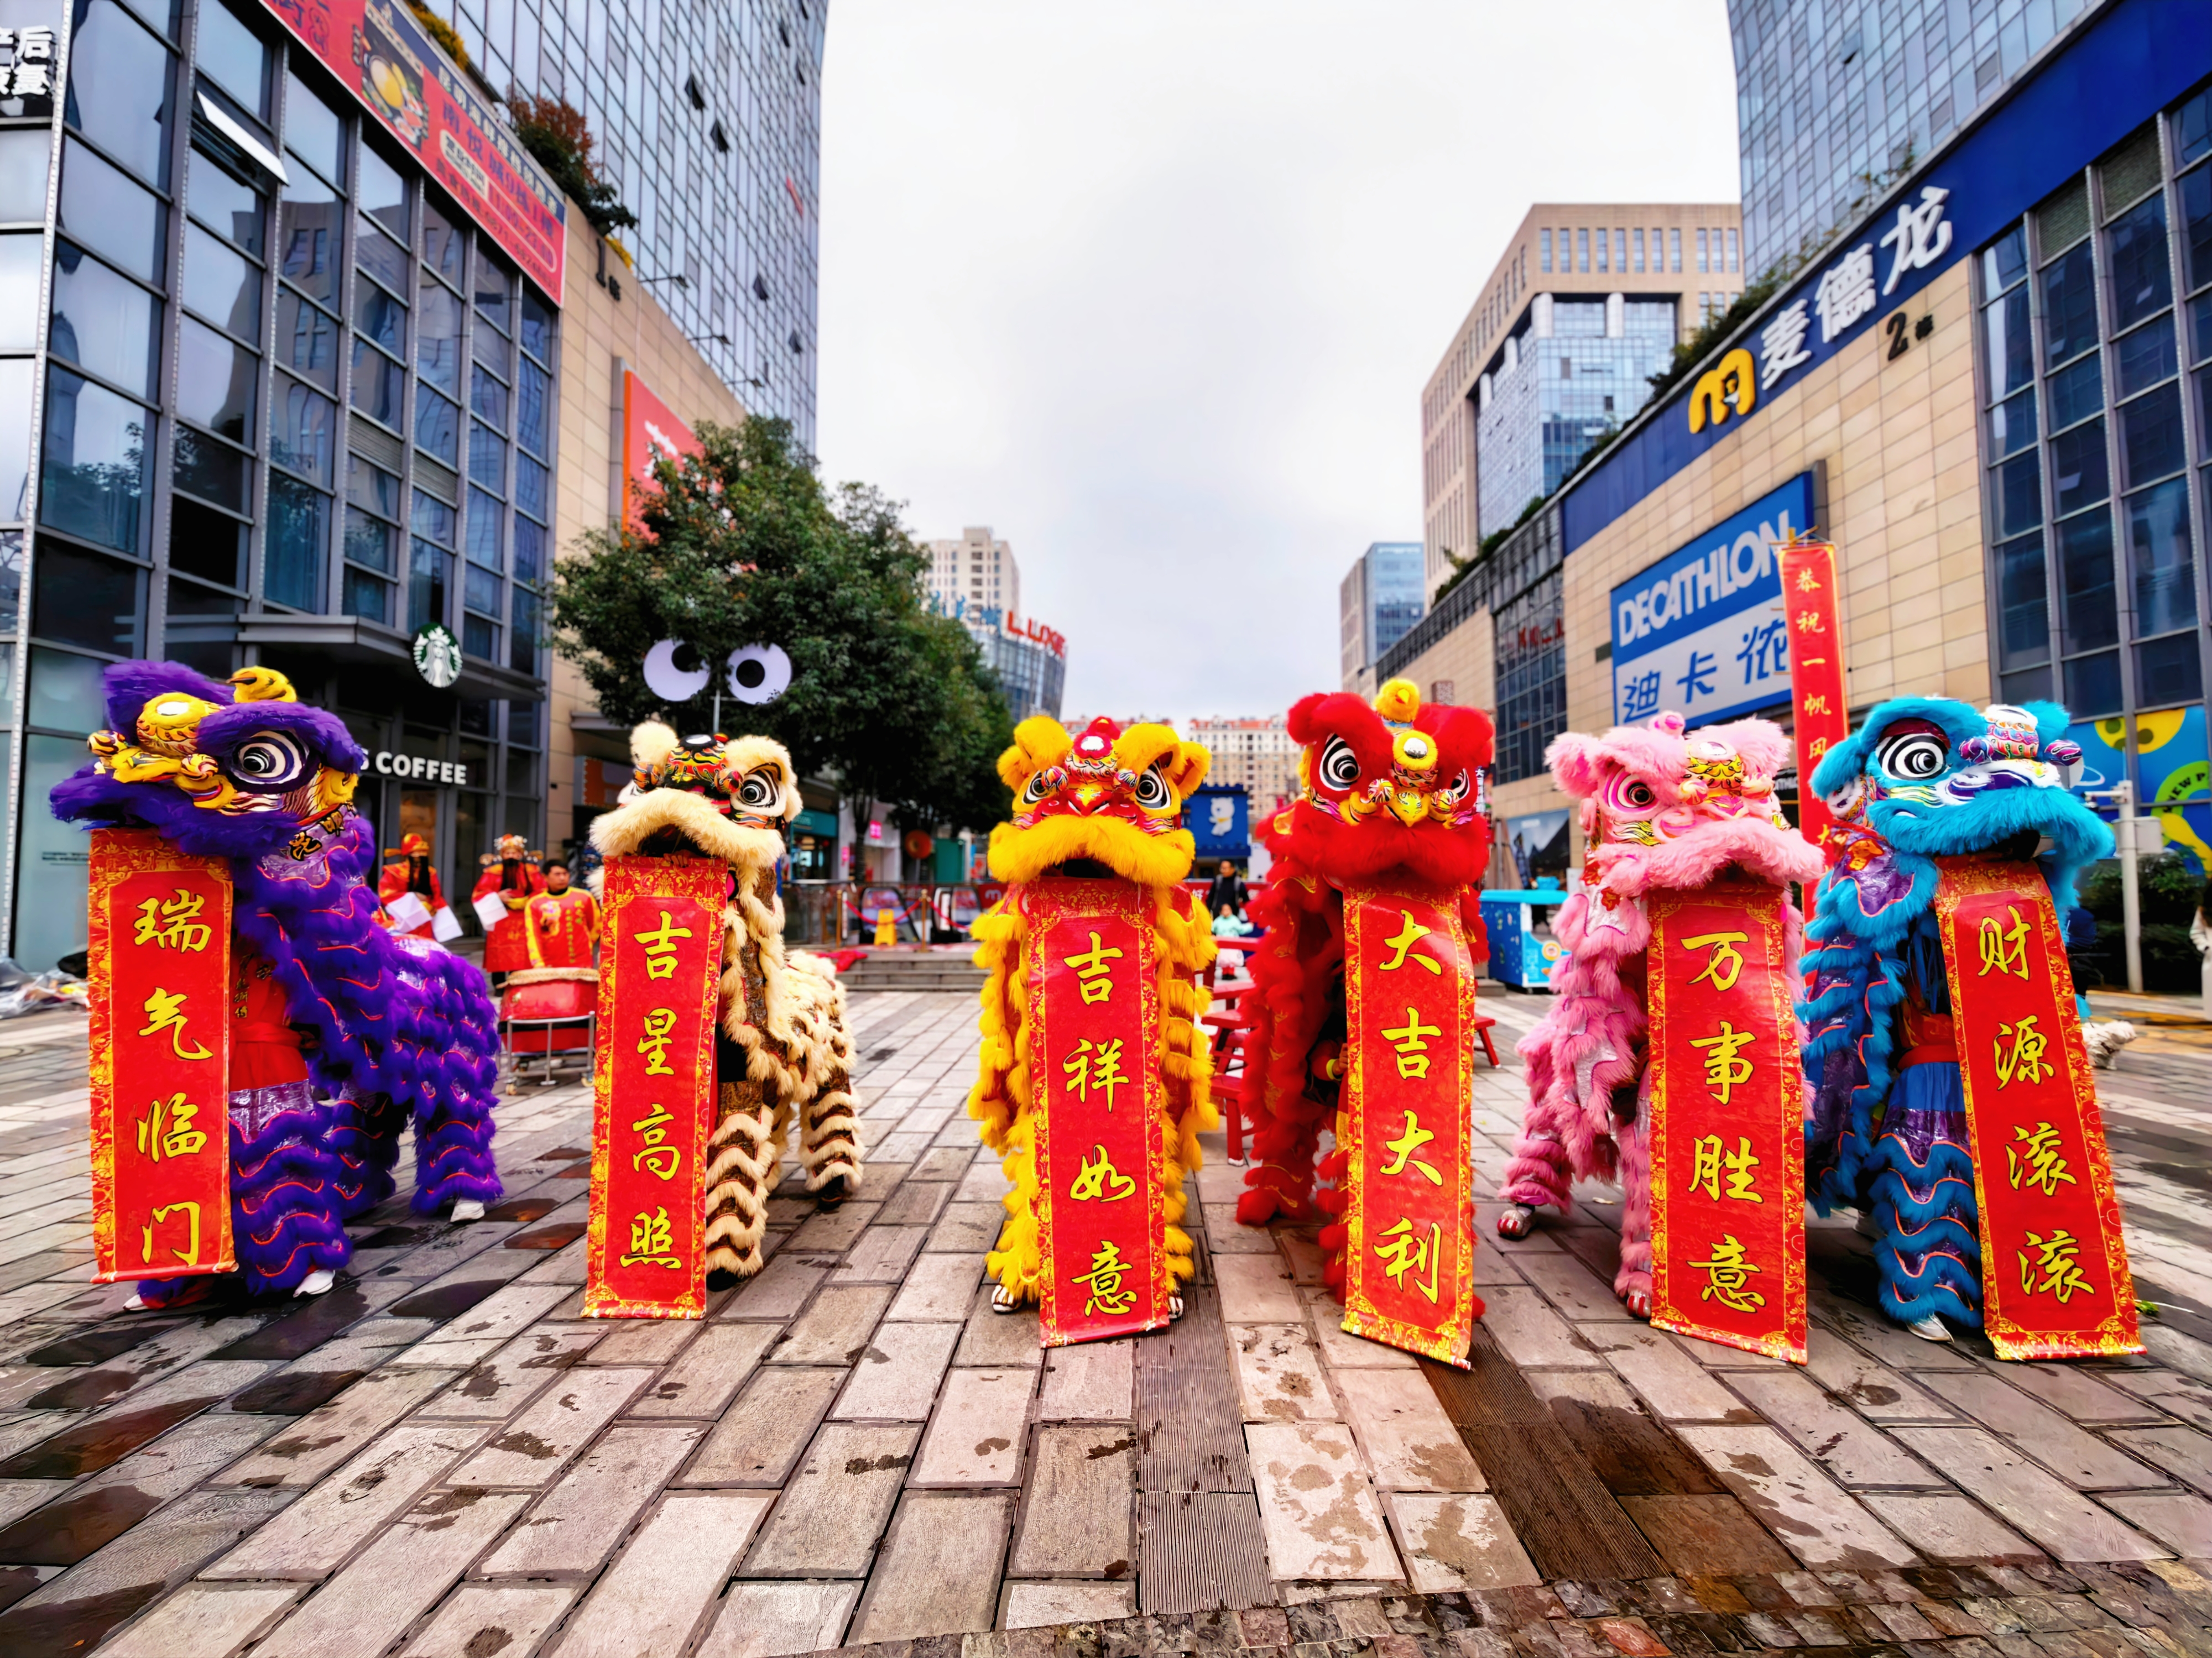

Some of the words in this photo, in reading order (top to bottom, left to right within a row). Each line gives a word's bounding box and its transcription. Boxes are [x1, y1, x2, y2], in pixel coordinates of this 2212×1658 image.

[1760, 185, 1953, 391] 麦德龙
[1618, 508, 1790, 648] DECATHLON
[1623, 616, 1787, 725] 迪卡侬
[375, 751, 467, 785] COFFEE
[133, 888, 214, 1267] 瑞气临门
[619, 909, 693, 1269] 吉星高照
[1062, 930, 1138, 1317] 吉祥如意
[1373, 908, 1443, 1305] 大吉大利
[1679, 930, 1767, 1314] 万事胜意
[1978, 904, 2096, 1304] 财源滚滚
